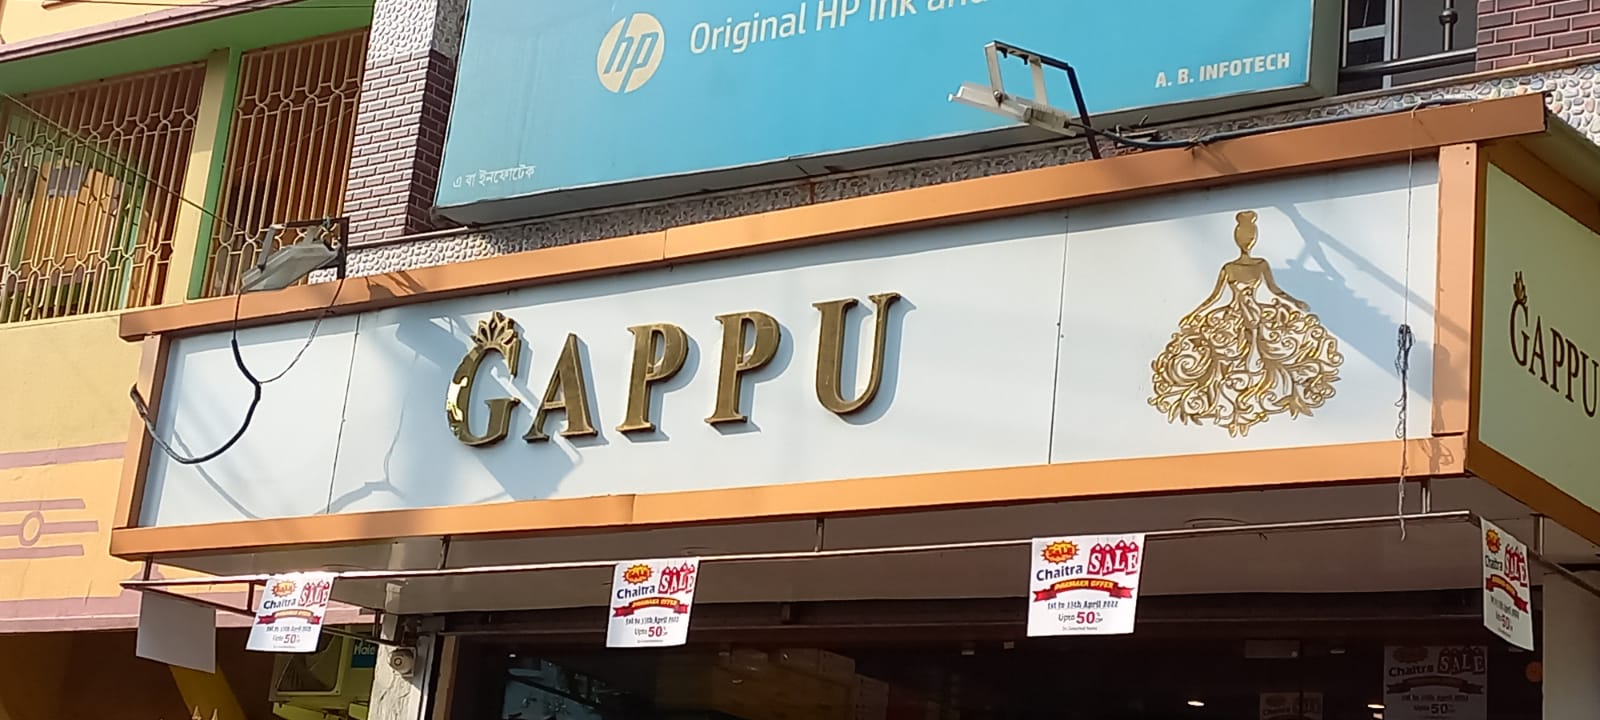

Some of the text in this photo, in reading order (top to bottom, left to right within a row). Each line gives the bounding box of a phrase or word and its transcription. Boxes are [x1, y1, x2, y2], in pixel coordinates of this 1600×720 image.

[690, 4, 806, 54] Original
[815, 0, 861, 31] HP
[600, 13, 662, 93] hp
[1155, 52, 1291, 88] A. B. INFOTECH
[1509, 283, 1599, 418] GAPPU
[446, 292, 902, 447] GAPPU
[1036, 546, 1139, 581] Chaitra SALE
[616, 566, 695, 600] Chaitra SALE
[263, 598, 297, 610] Chaitra
[1076, 611, 1096, 624] 50
[1083, 600, 1101, 609] April
[284, 633, 297, 644] 50
[648, 626, 663, 638] 50
[1431, 703, 1448, 714] 50
